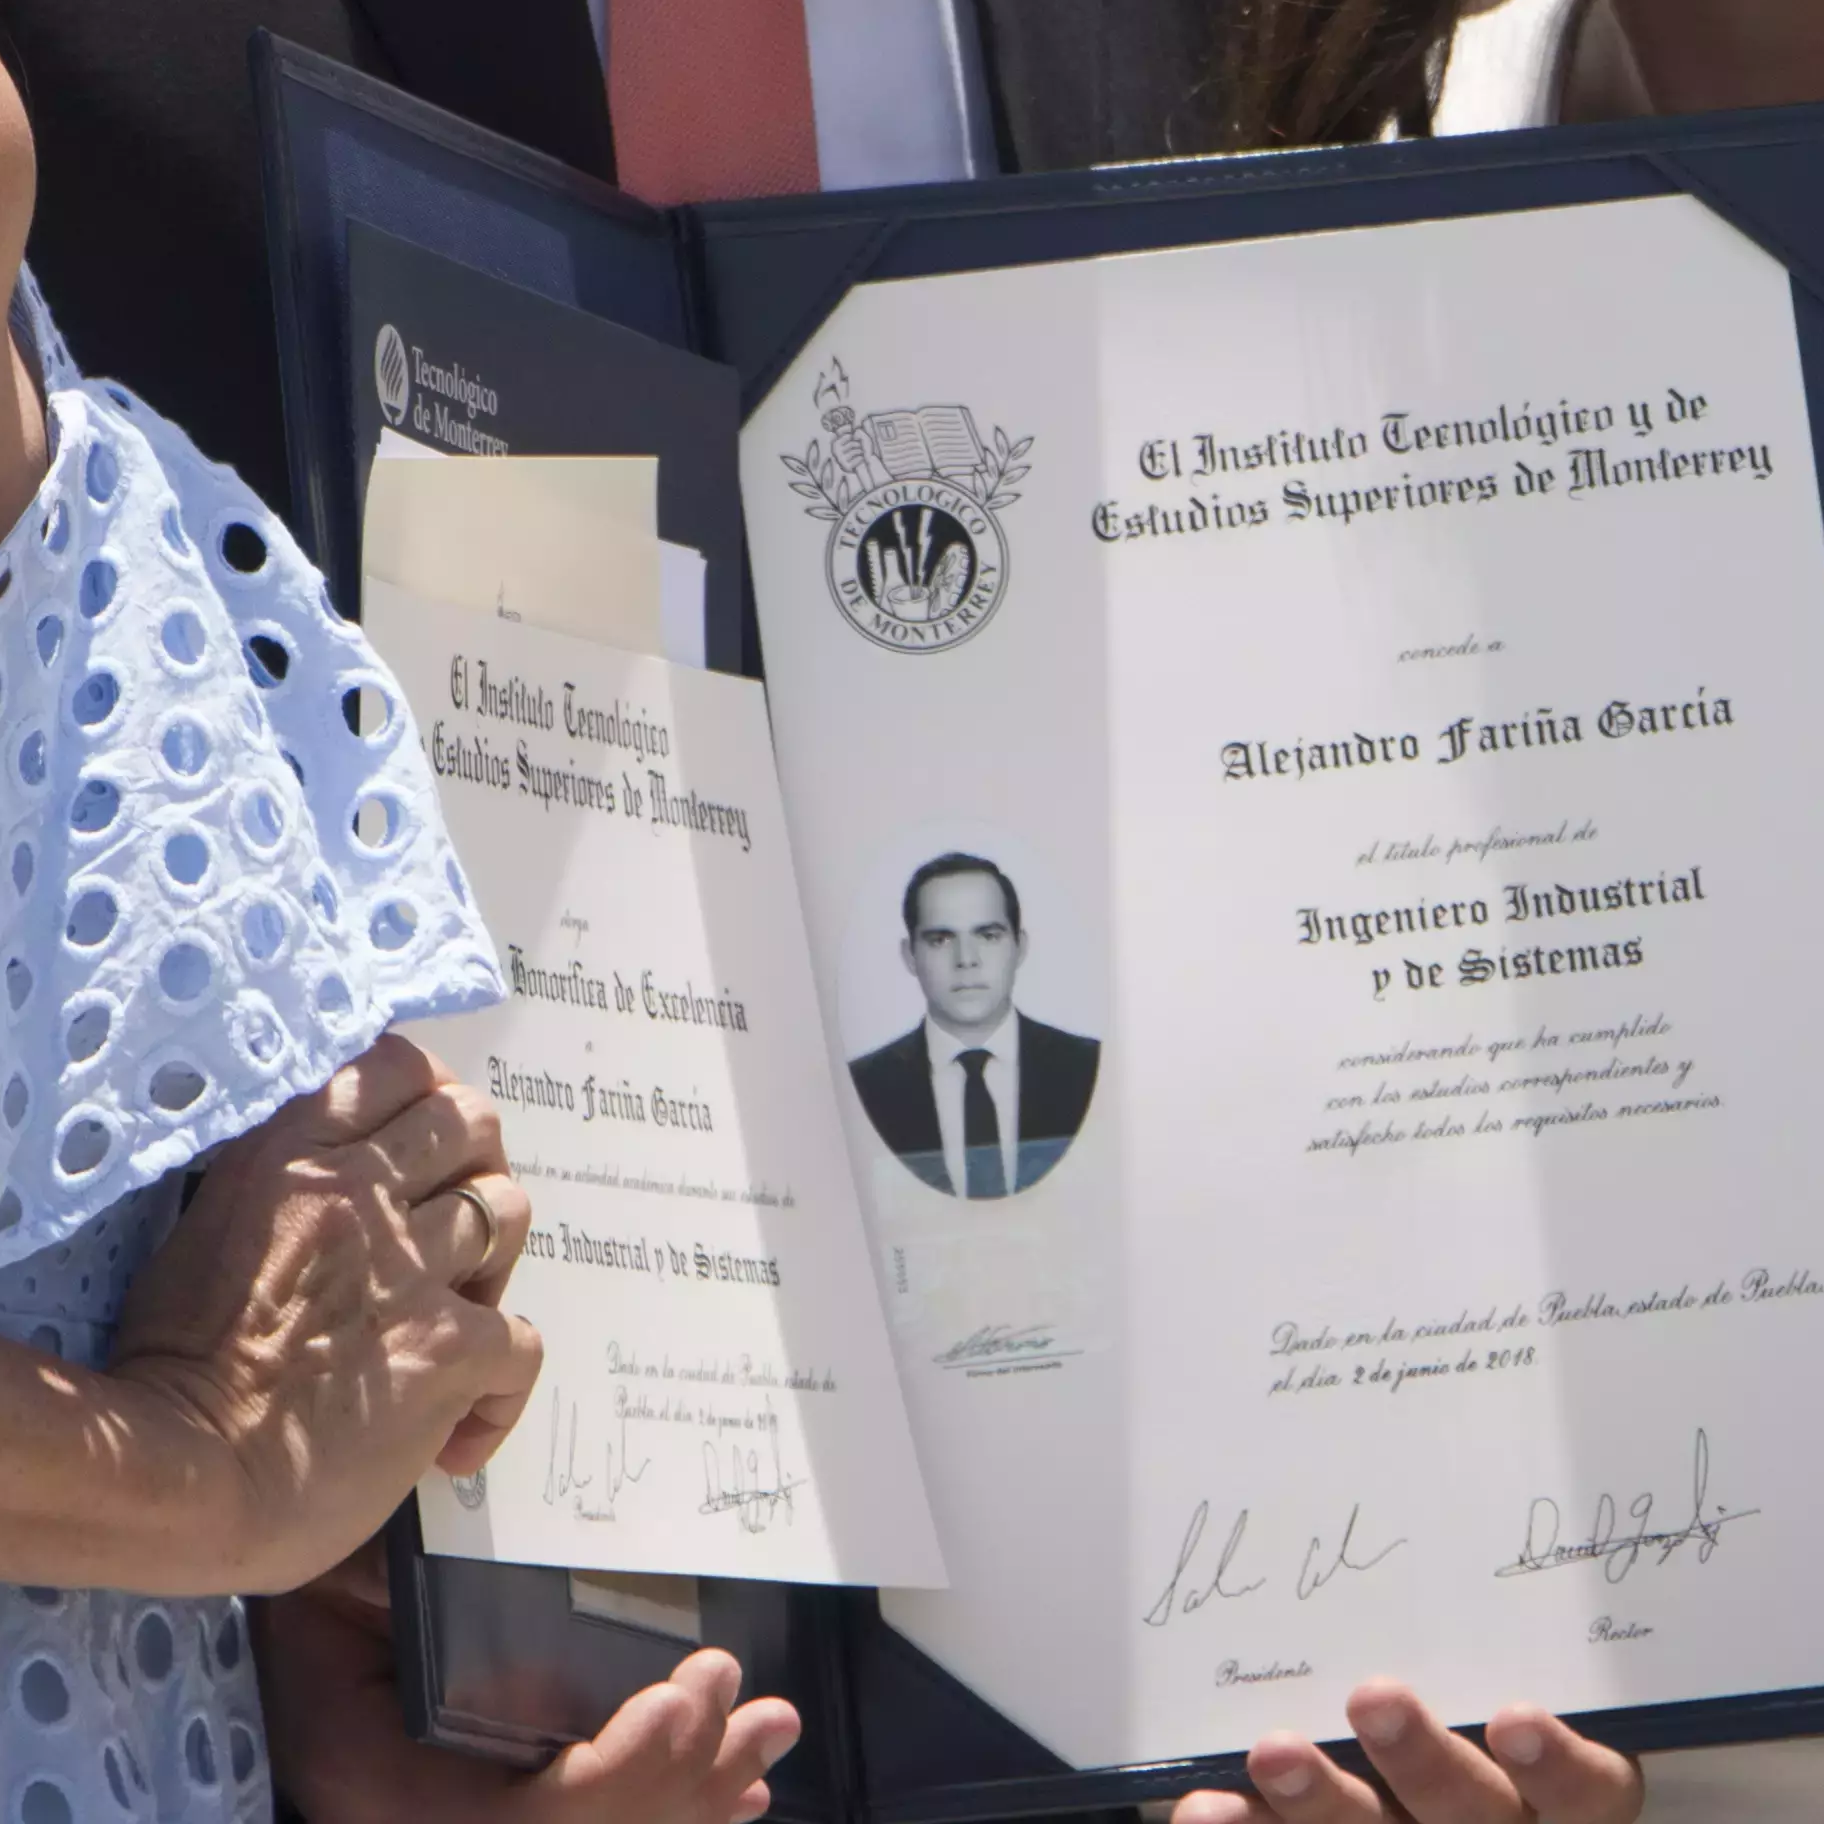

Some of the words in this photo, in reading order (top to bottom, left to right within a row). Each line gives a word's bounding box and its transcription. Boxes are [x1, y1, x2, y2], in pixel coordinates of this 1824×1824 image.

[412, 345, 498, 419] Tecnológico
[413, 393, 431, 435] de
[1139, 439, 1182, 481] El
[1191, 428, 1369, 485] Instituto
[1380, 397, 1614, 455] Tecnológico
[1626, 401, 1654, 438] y
[1666, 388, 1709, 424] de
[839, 485, 986, 551] TECNOLOGICO
[1091, 493, 1269, 544] Estudios
[1281, 473, 1498, 526] Superiores
[1514, 461, 1556, 497] de
[1568, 444, 1774, 501] Monterrey
[840, 580, 869, 613] DE
[873, 560, 997, 642] MONTERREY
[1396, 635, 1481, 664] concede
[1486, 638, 1506, 654] a
[450, 654, 469, 711] El
[477, 659, 554, 731] Instituto
[563, 681, 670, 764] Tecnológico
[1220, 731, 1421, 783] Alejandro
[1436, 708, 1585, 765] Fariña
[1597, 686, 1736, 740] García
[432, 720, 510, 791] Estudios
[516, 738, 616, 812] Superiores
[623, 771, 643, 819] de
[648, 769, 752, 854] Monterrey
[1355, 841, 1377, 868] el
[1446, 819, 1567, 864] profesional
[1571, 818, 1599, 844] de
[1296, 896, 1490, 947] Ingeniero
[1503, 865, 1707, 923] Industrial
[614, 970, 636, 1014] de
[641, 969, 749, 1033] Excelencia
[1371, 966, 1391, 1002] y
[1403, 958, 1444, 991] de
[1458, 935, 1644, 988] Sistemas
[1336, 1039, 1480, 1072] considerando
[1487, 1037, 1526, 1064] que
[1530, 1024, 1560, 1049] ha
[1568, 1012, 1673, 1050] cumplido
[488, 1054, 575, 1113] Alejandro
[581, 1073, 646, 1122] Fariña
[1325, 1093, 1367, 1112] con
[1371, 1080, 1401, 1107] los
[1408, 1073, 1491, 1102] estudios
[1496, 1054, 1671, 1096] correspondientes
[1671, 1058, 1695, 1090] y
[1305, 1119, 1407, 1157] satisfecho
[1410, 1111, 1466, 1142] todos
[1474, 1109, 1503, 1134] los
[1510, 1101, 1609, 1137] requisitos
[559, 1223, 651, 1273] Industrial
[654, 1243, 664, 1281] y
[666, 1241, 688, 1277] de
[693, 1241, 780, 1287] Sistemas
[1269, 1321, 1338, 1357] Dado
[1341, 1331, 1376, 1351] en
[1378, 1318, 1409, 1349] la
[1413, 1305, 1496, 1344] ciudad
[1498, 1303, 1530, 1330] de
[1624, 1288, 1699, 1317] estado
[1702, 1280, 1735, 1308] de
[1268, 1367, 1293, 1398] el
[1353, 1365, 1366, 1386] 2
[1368, 1358, 1393, 1384] de
[1393, 1358, 1451, 1394] junio
[1454, 1349, 1479, 1374] de
[1588, 1615, 1655, 1645] Rector
[1216, 1658, 1314, 1689] Presidente
